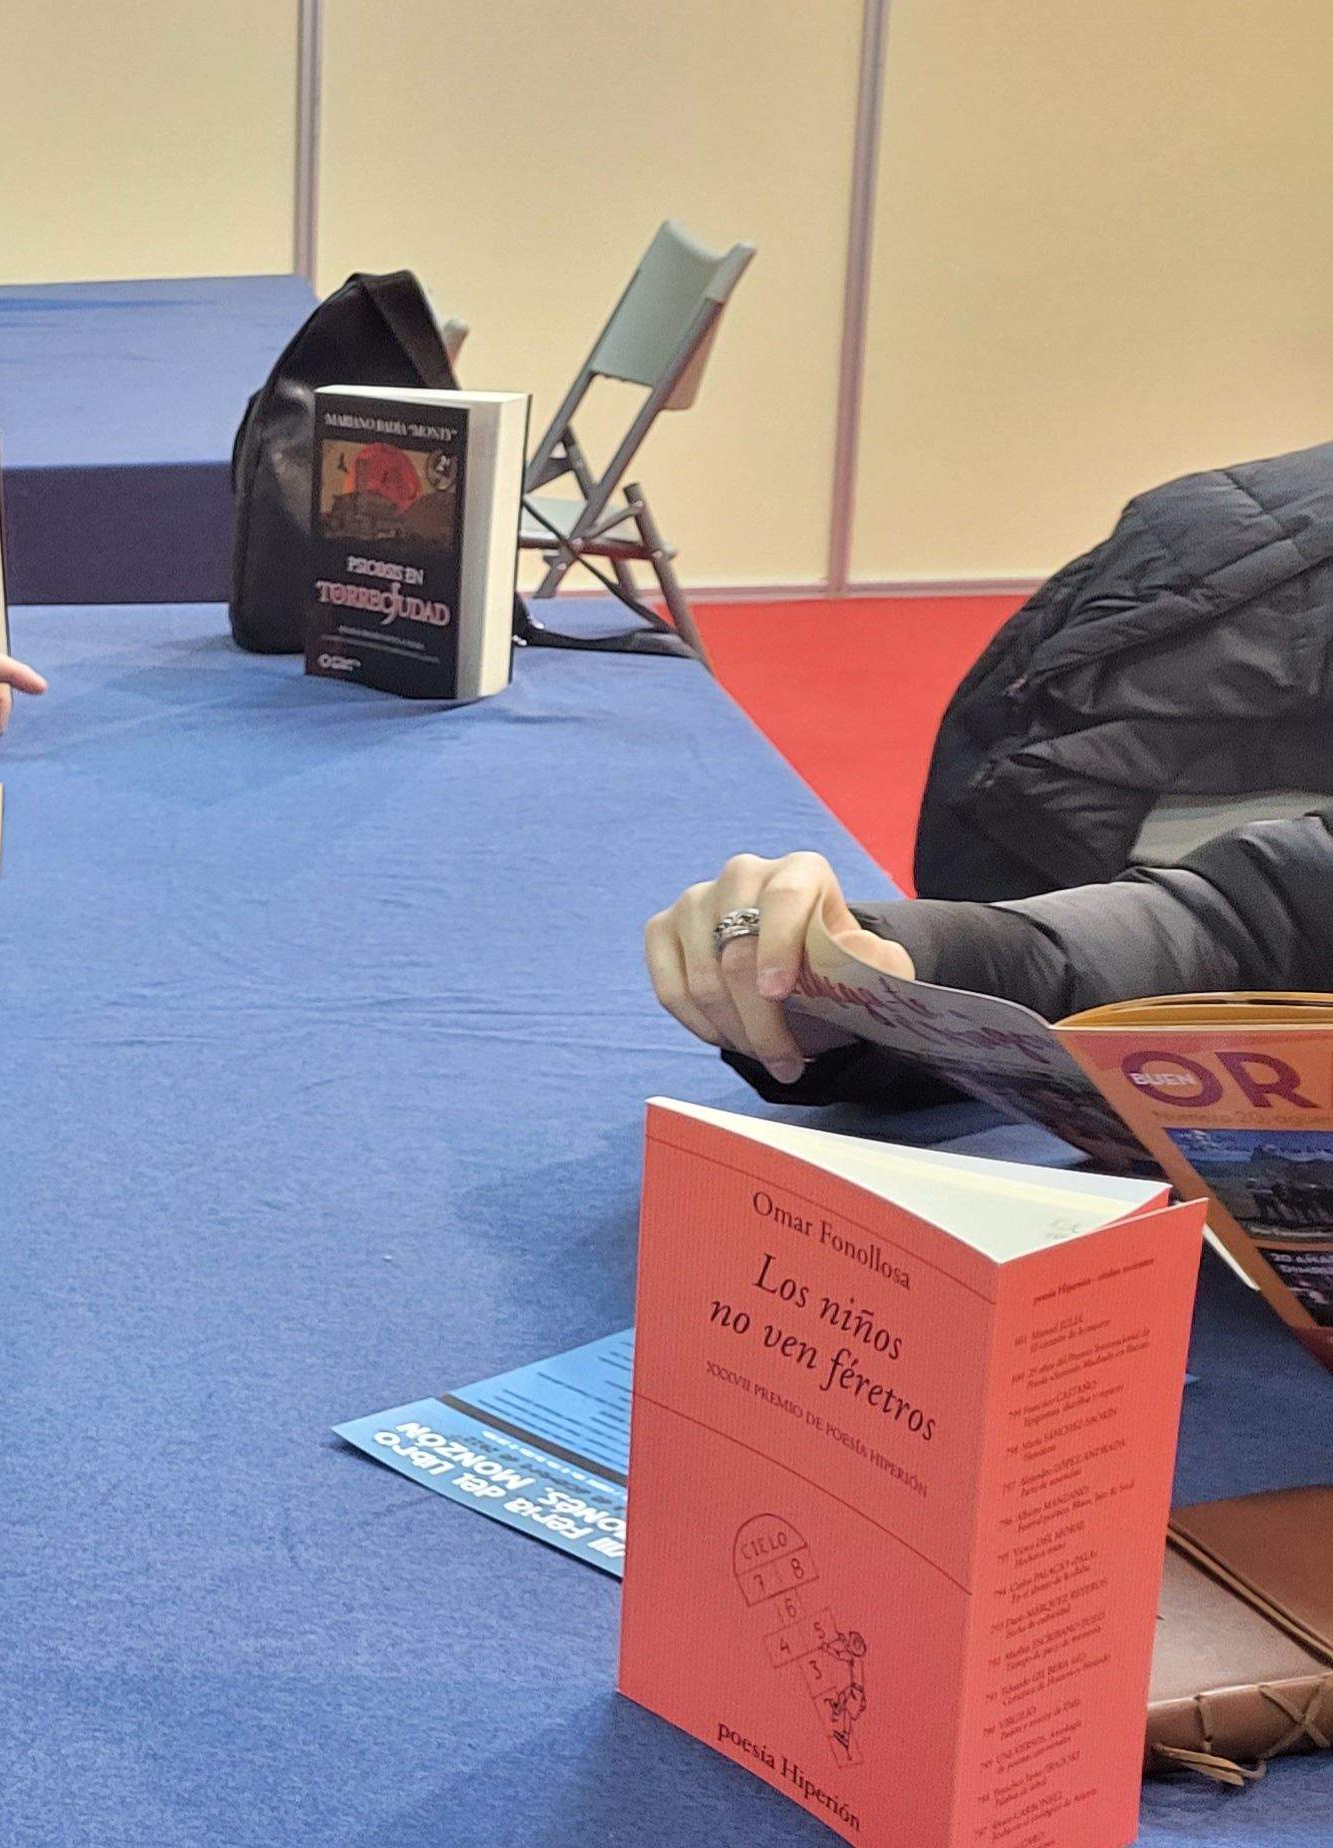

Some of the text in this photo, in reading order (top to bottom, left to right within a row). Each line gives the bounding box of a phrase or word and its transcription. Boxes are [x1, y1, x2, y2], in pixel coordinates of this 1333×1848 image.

[405, 566, 424, 587] EN
[752, 1191, 911, 1291] Omar Fonollosa
[752, 1252, 903, 1361] Los niños
[709, 1300, 937, 1442] no ven féretros
[395, 1422, 535, 1491] MONZÓN
[753, 1385, 804, 1419] PREMIO
[805, 1410, 824, 1431] DE
[869, 1448, 930, 1498] HIPERIÓN
[740, 1530, 789, 1561] CIELO
[753, 1557, 805, 1593] 7 8
[784, 1597, 797, 1619] 6
[812, 1621, 826, 1640] 5
[808, 1659, 823, 1680] 3
[780, 1756, 862, 1834] Hiperión
